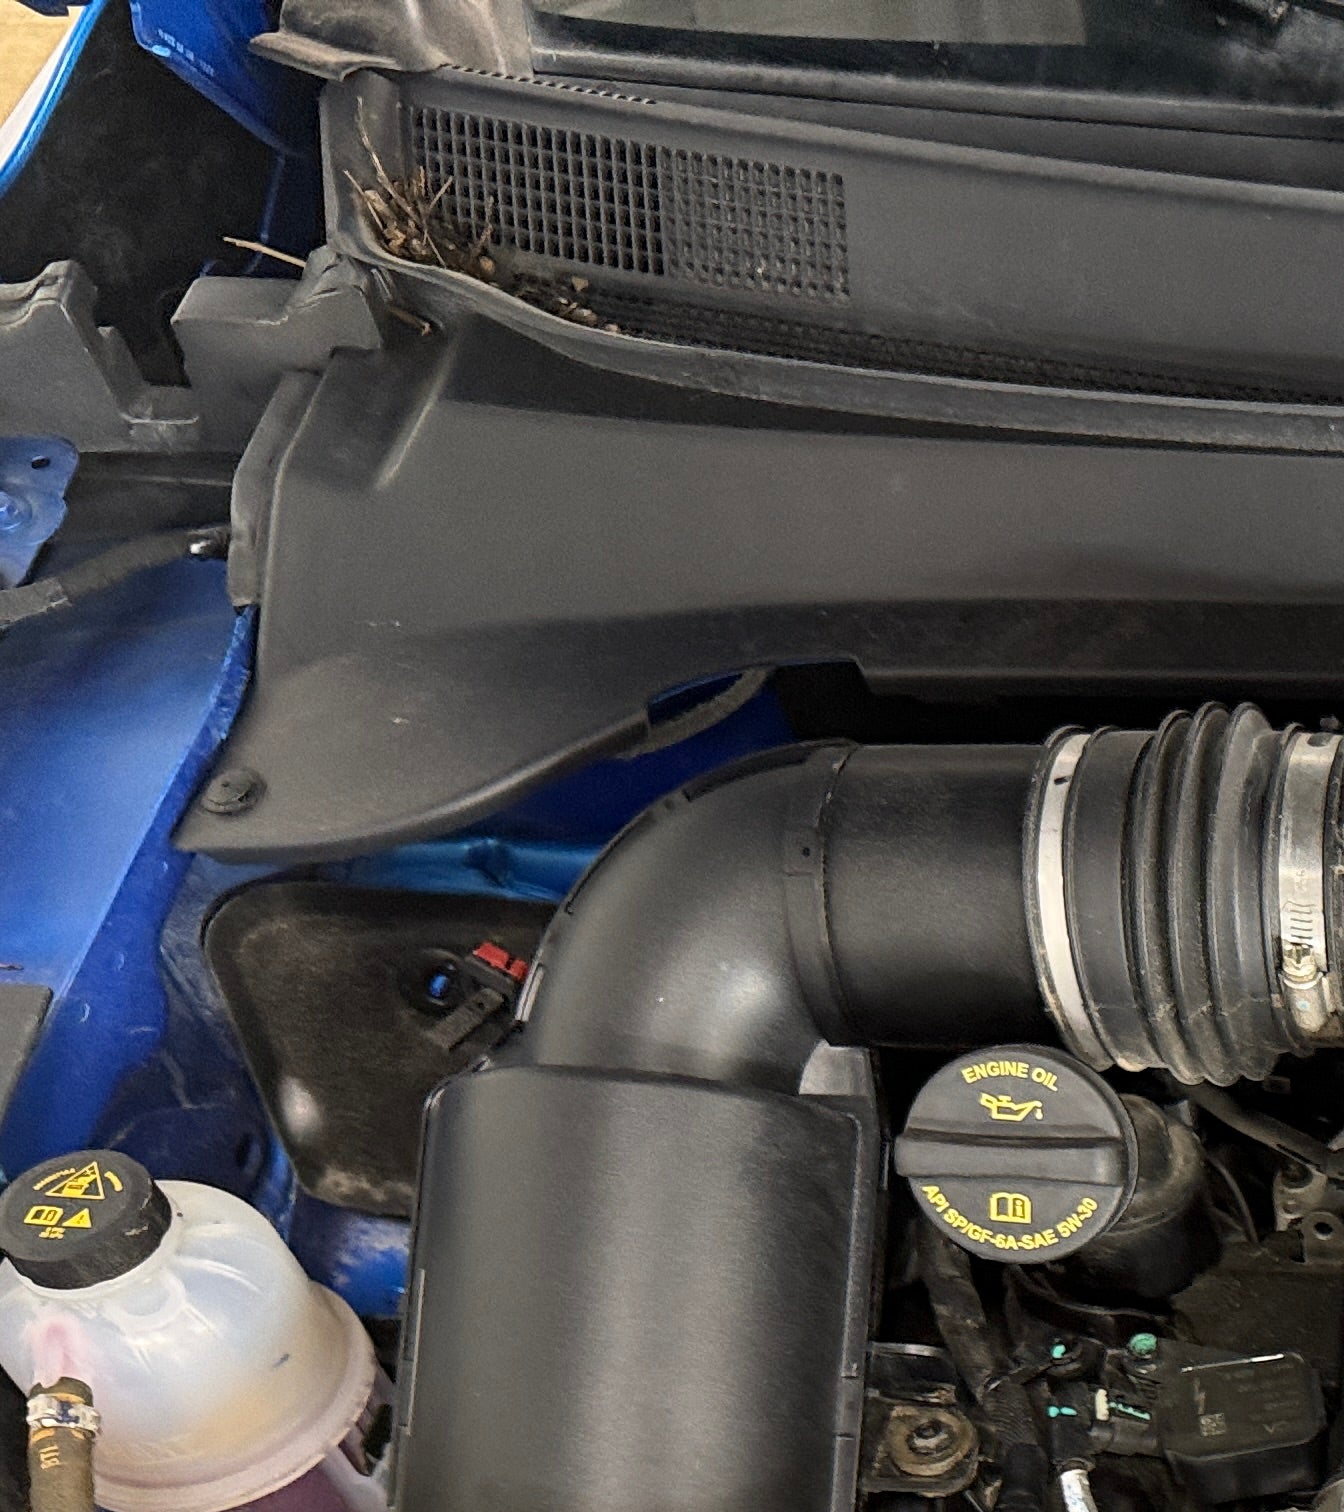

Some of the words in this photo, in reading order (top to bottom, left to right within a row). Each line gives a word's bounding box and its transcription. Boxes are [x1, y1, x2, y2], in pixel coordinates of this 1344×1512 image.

[960, 1061, 1029, 1084] ENGINE
[1032, 1067, 1059, 1092] OIL
[921, 1185, 950, 1213] API
[944, 1209, 1058, 1251] SP/GF-6A-SAE
[1057, 1197, 1098, 1238] 5W-30
